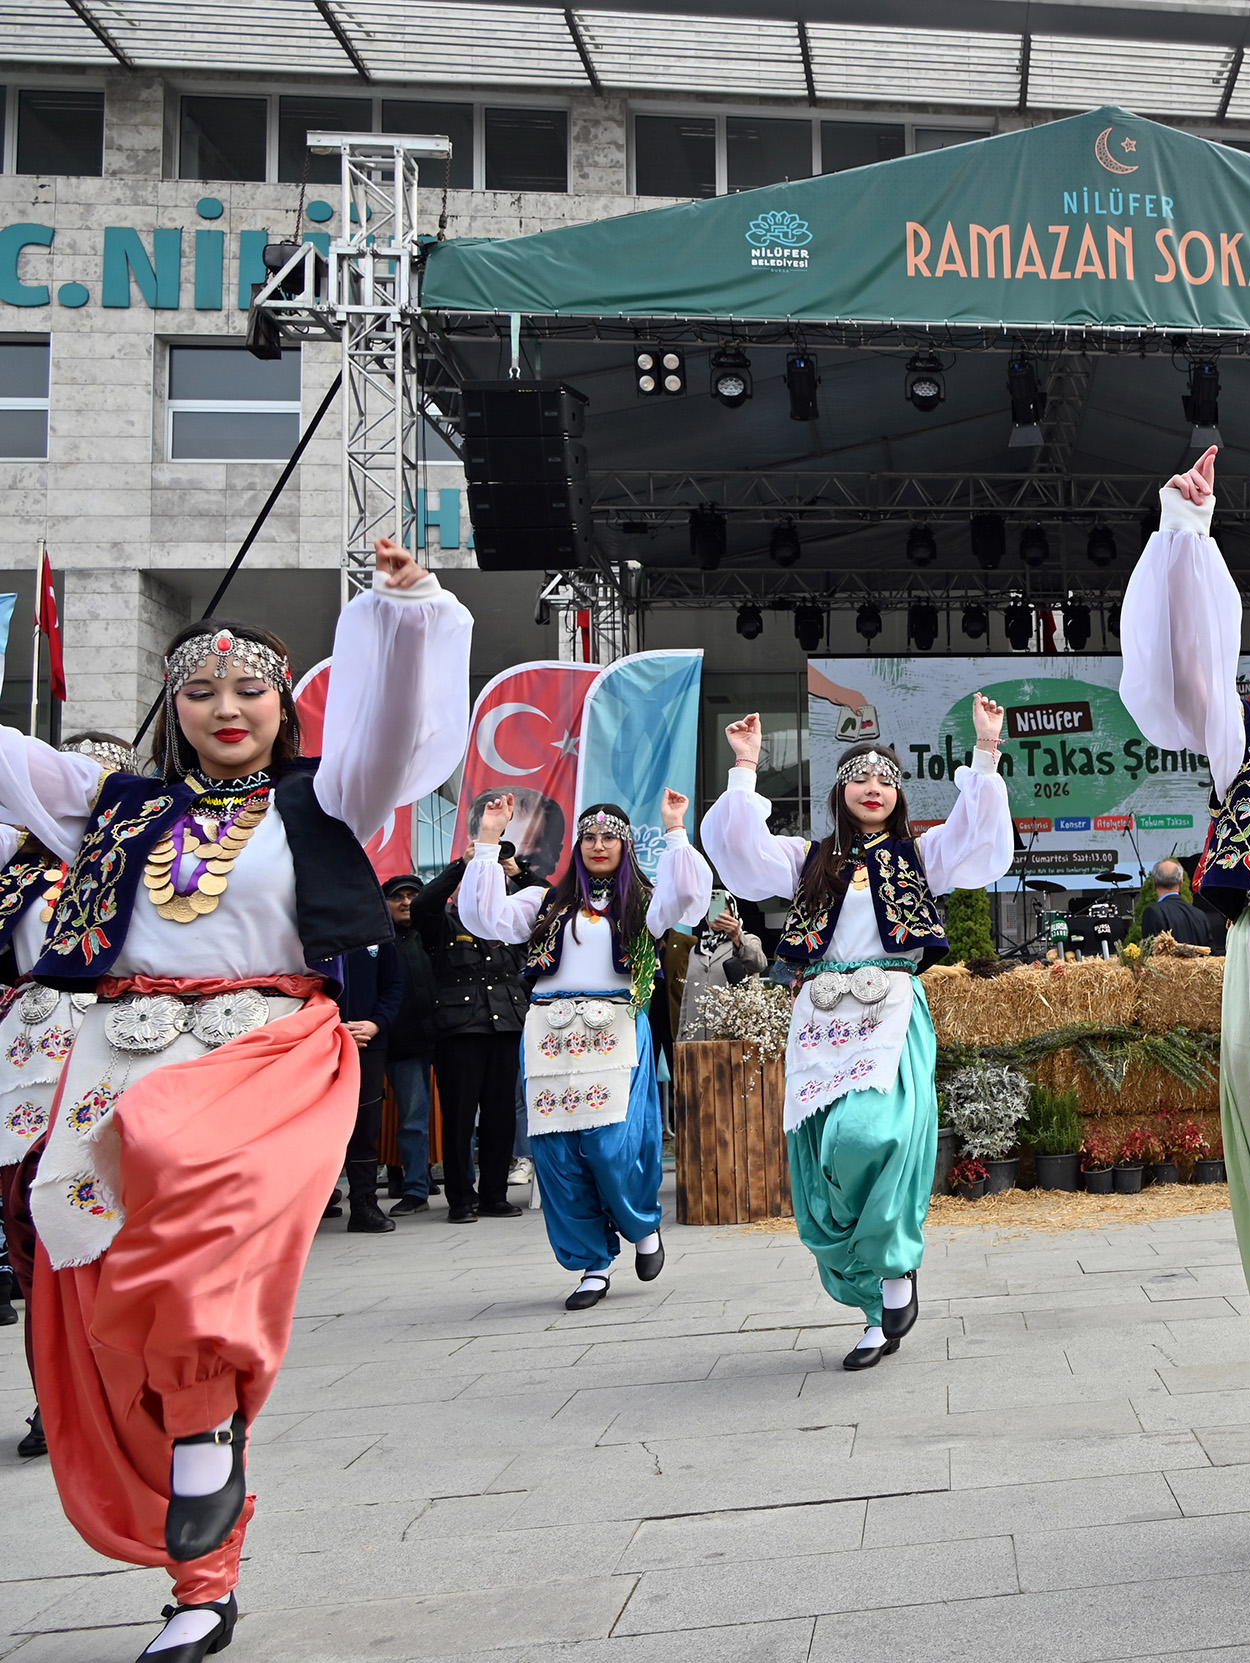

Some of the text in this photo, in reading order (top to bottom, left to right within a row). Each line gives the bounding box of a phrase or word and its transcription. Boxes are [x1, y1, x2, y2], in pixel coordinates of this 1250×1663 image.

[1063, 186, 1175, 219] NİLÜFER
[751, 247, 810, 259] NİLÜFER
[906, 220, 1134, 280] RAMAZAN
[751, 258, 808, 268] BELEDİYESİ
[1015, 708, 1084, 733] Nilüfer
[1019, 740, 1116, 777] Takas
[1034, 782, 1071, 799] 2026
[1060, 820, 1087, 829] Konser
[1140, 816, 1165, 827] Tohum
[1013, 853, 1113, 863] art Cumartesi Saat:13.00
